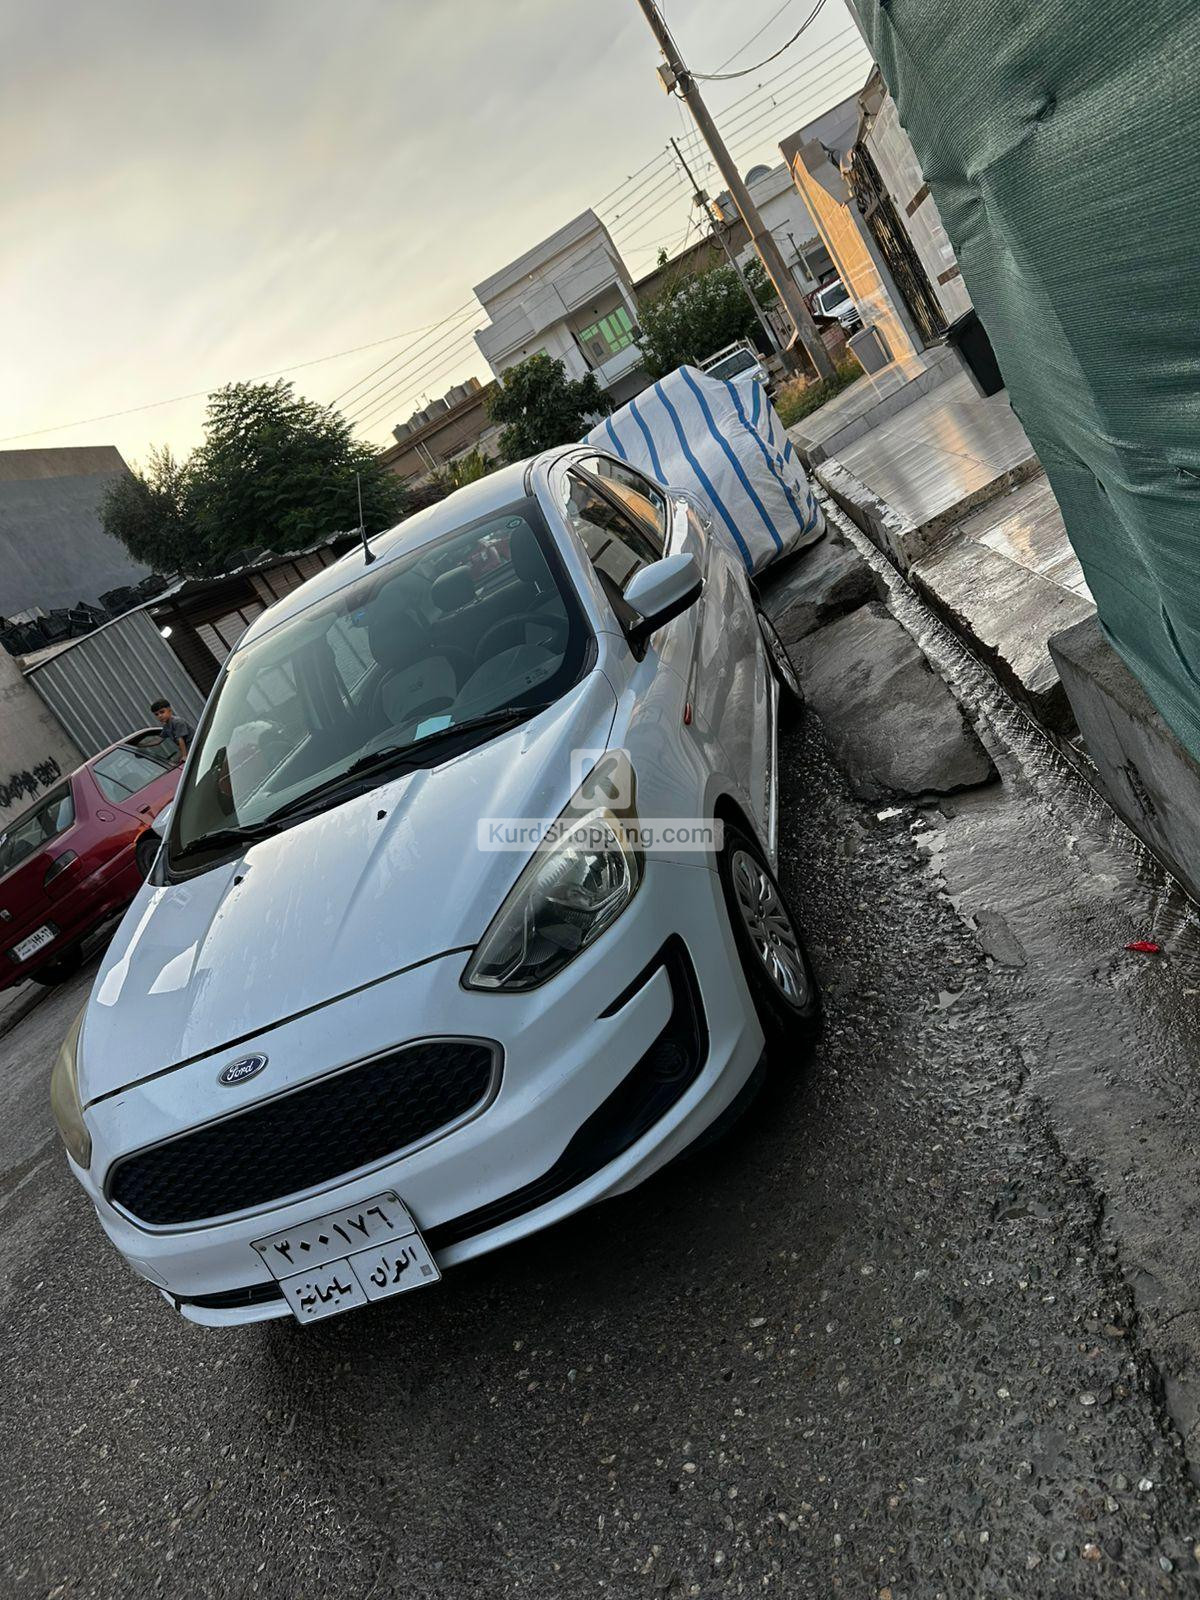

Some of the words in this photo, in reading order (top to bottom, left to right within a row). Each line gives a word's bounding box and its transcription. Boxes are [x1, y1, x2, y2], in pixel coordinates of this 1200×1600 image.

[227, 1060, 254, 1081] Ford
[370, 1246, 418, 1288] العراق
[295, 1276, 352, 1313] سليمانية
